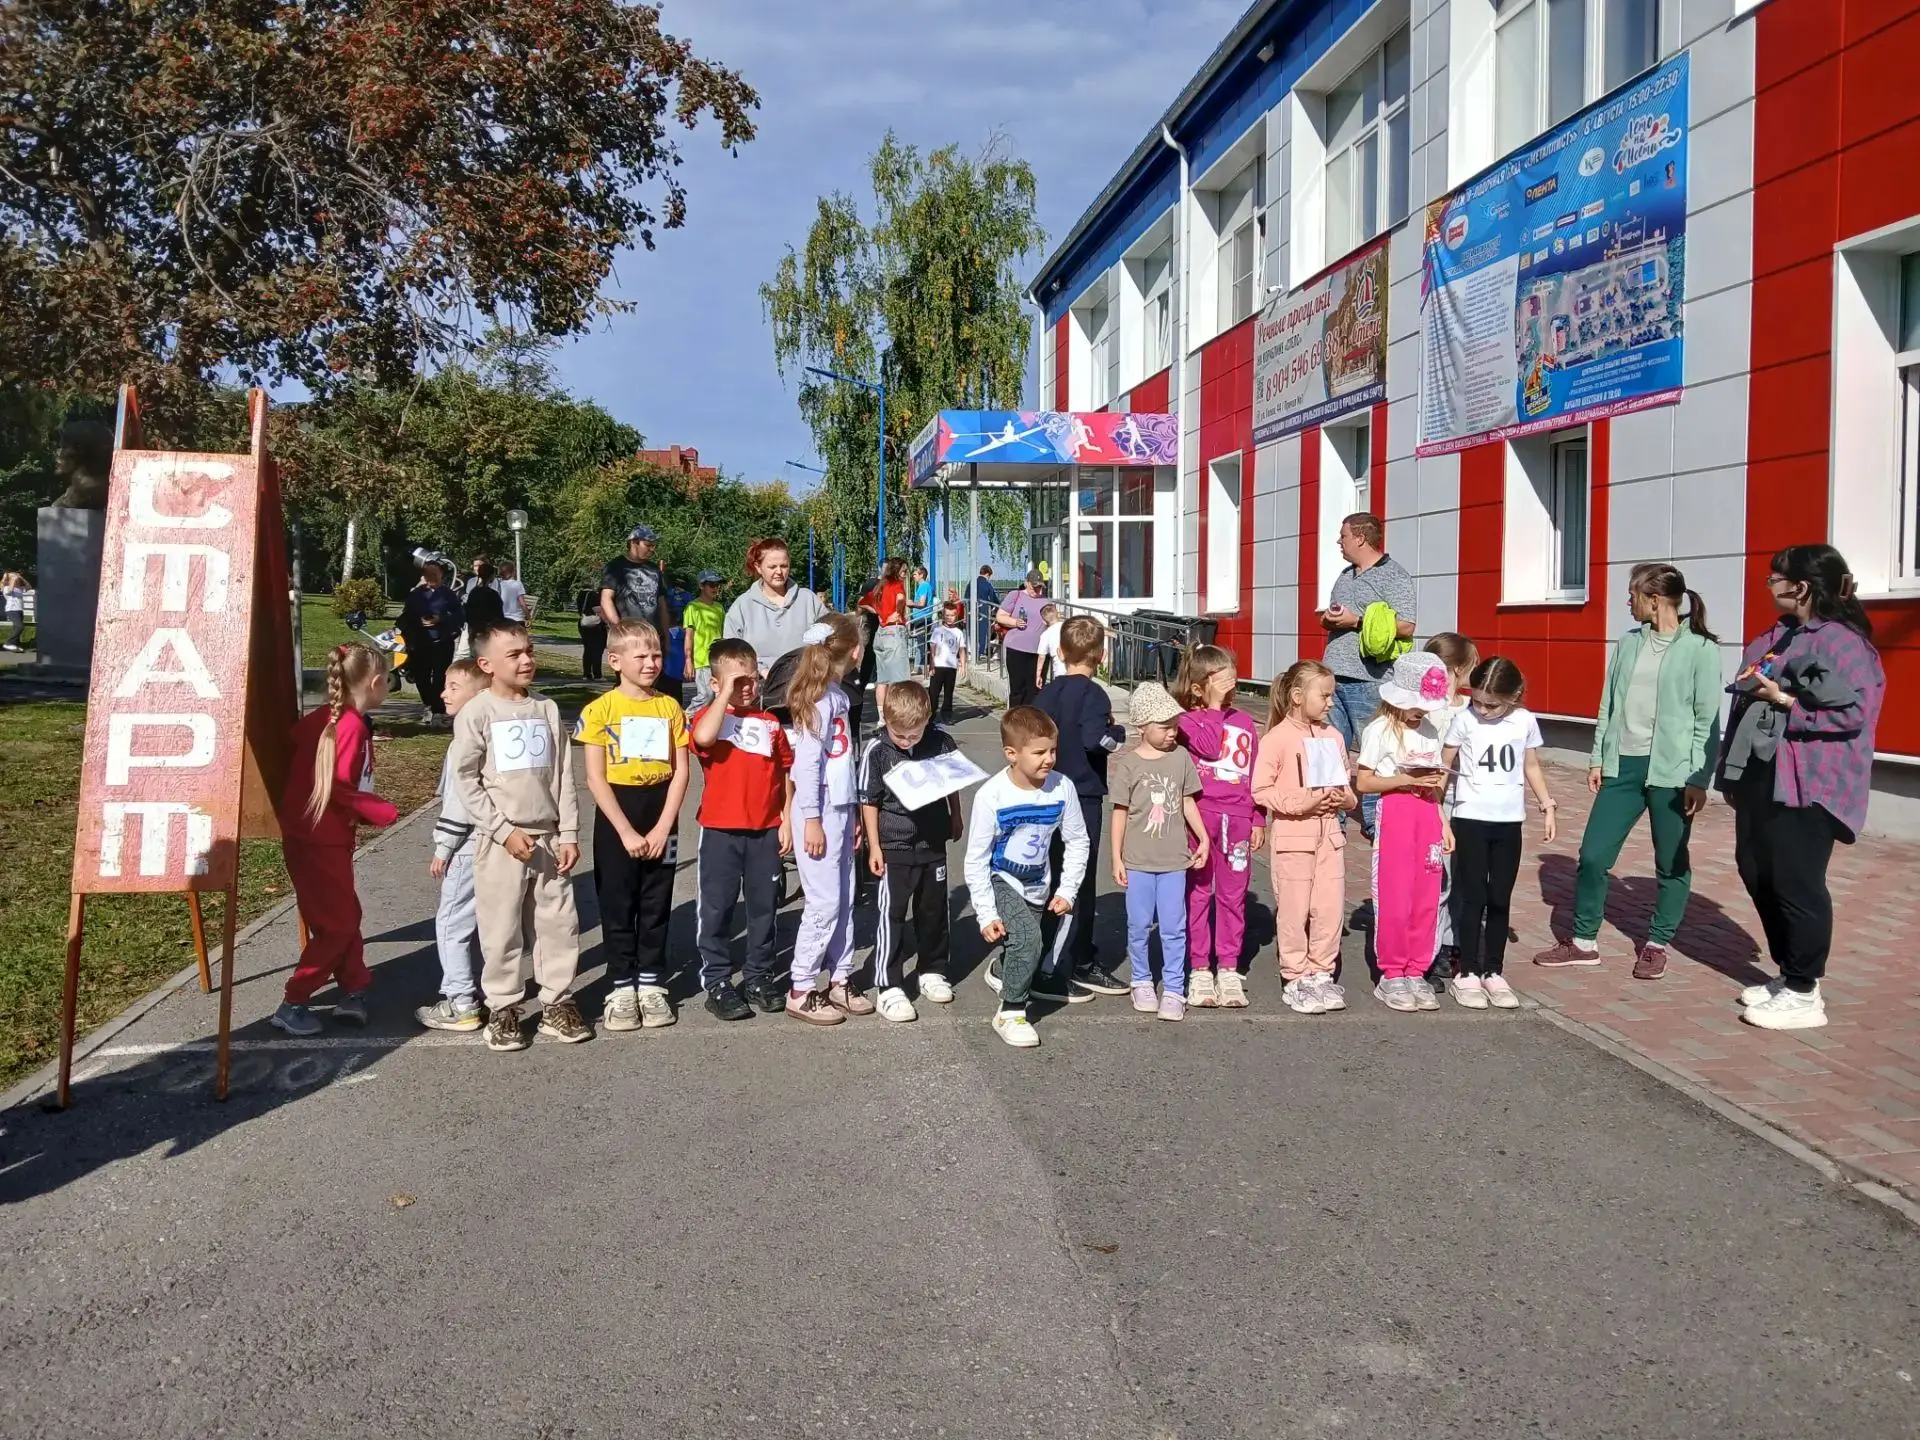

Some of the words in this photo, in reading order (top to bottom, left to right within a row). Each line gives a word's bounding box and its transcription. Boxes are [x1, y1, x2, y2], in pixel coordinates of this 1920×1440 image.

[1628, 69, 1679, 111] 15:00-22:30
[1532, 178, 1556, 200] ЛЕНТА
[1257, 314, 1285, 346] Речные
[1288, 290, 1331, 334] прогулки
[1273, 363, 1289, 397] 904
[1291, 349, 1309, 385] 546
[1311, 339, 1323, 370] 69
[504, 723, 546, 760] 35
[1478, 743, 1515, 774] 40
